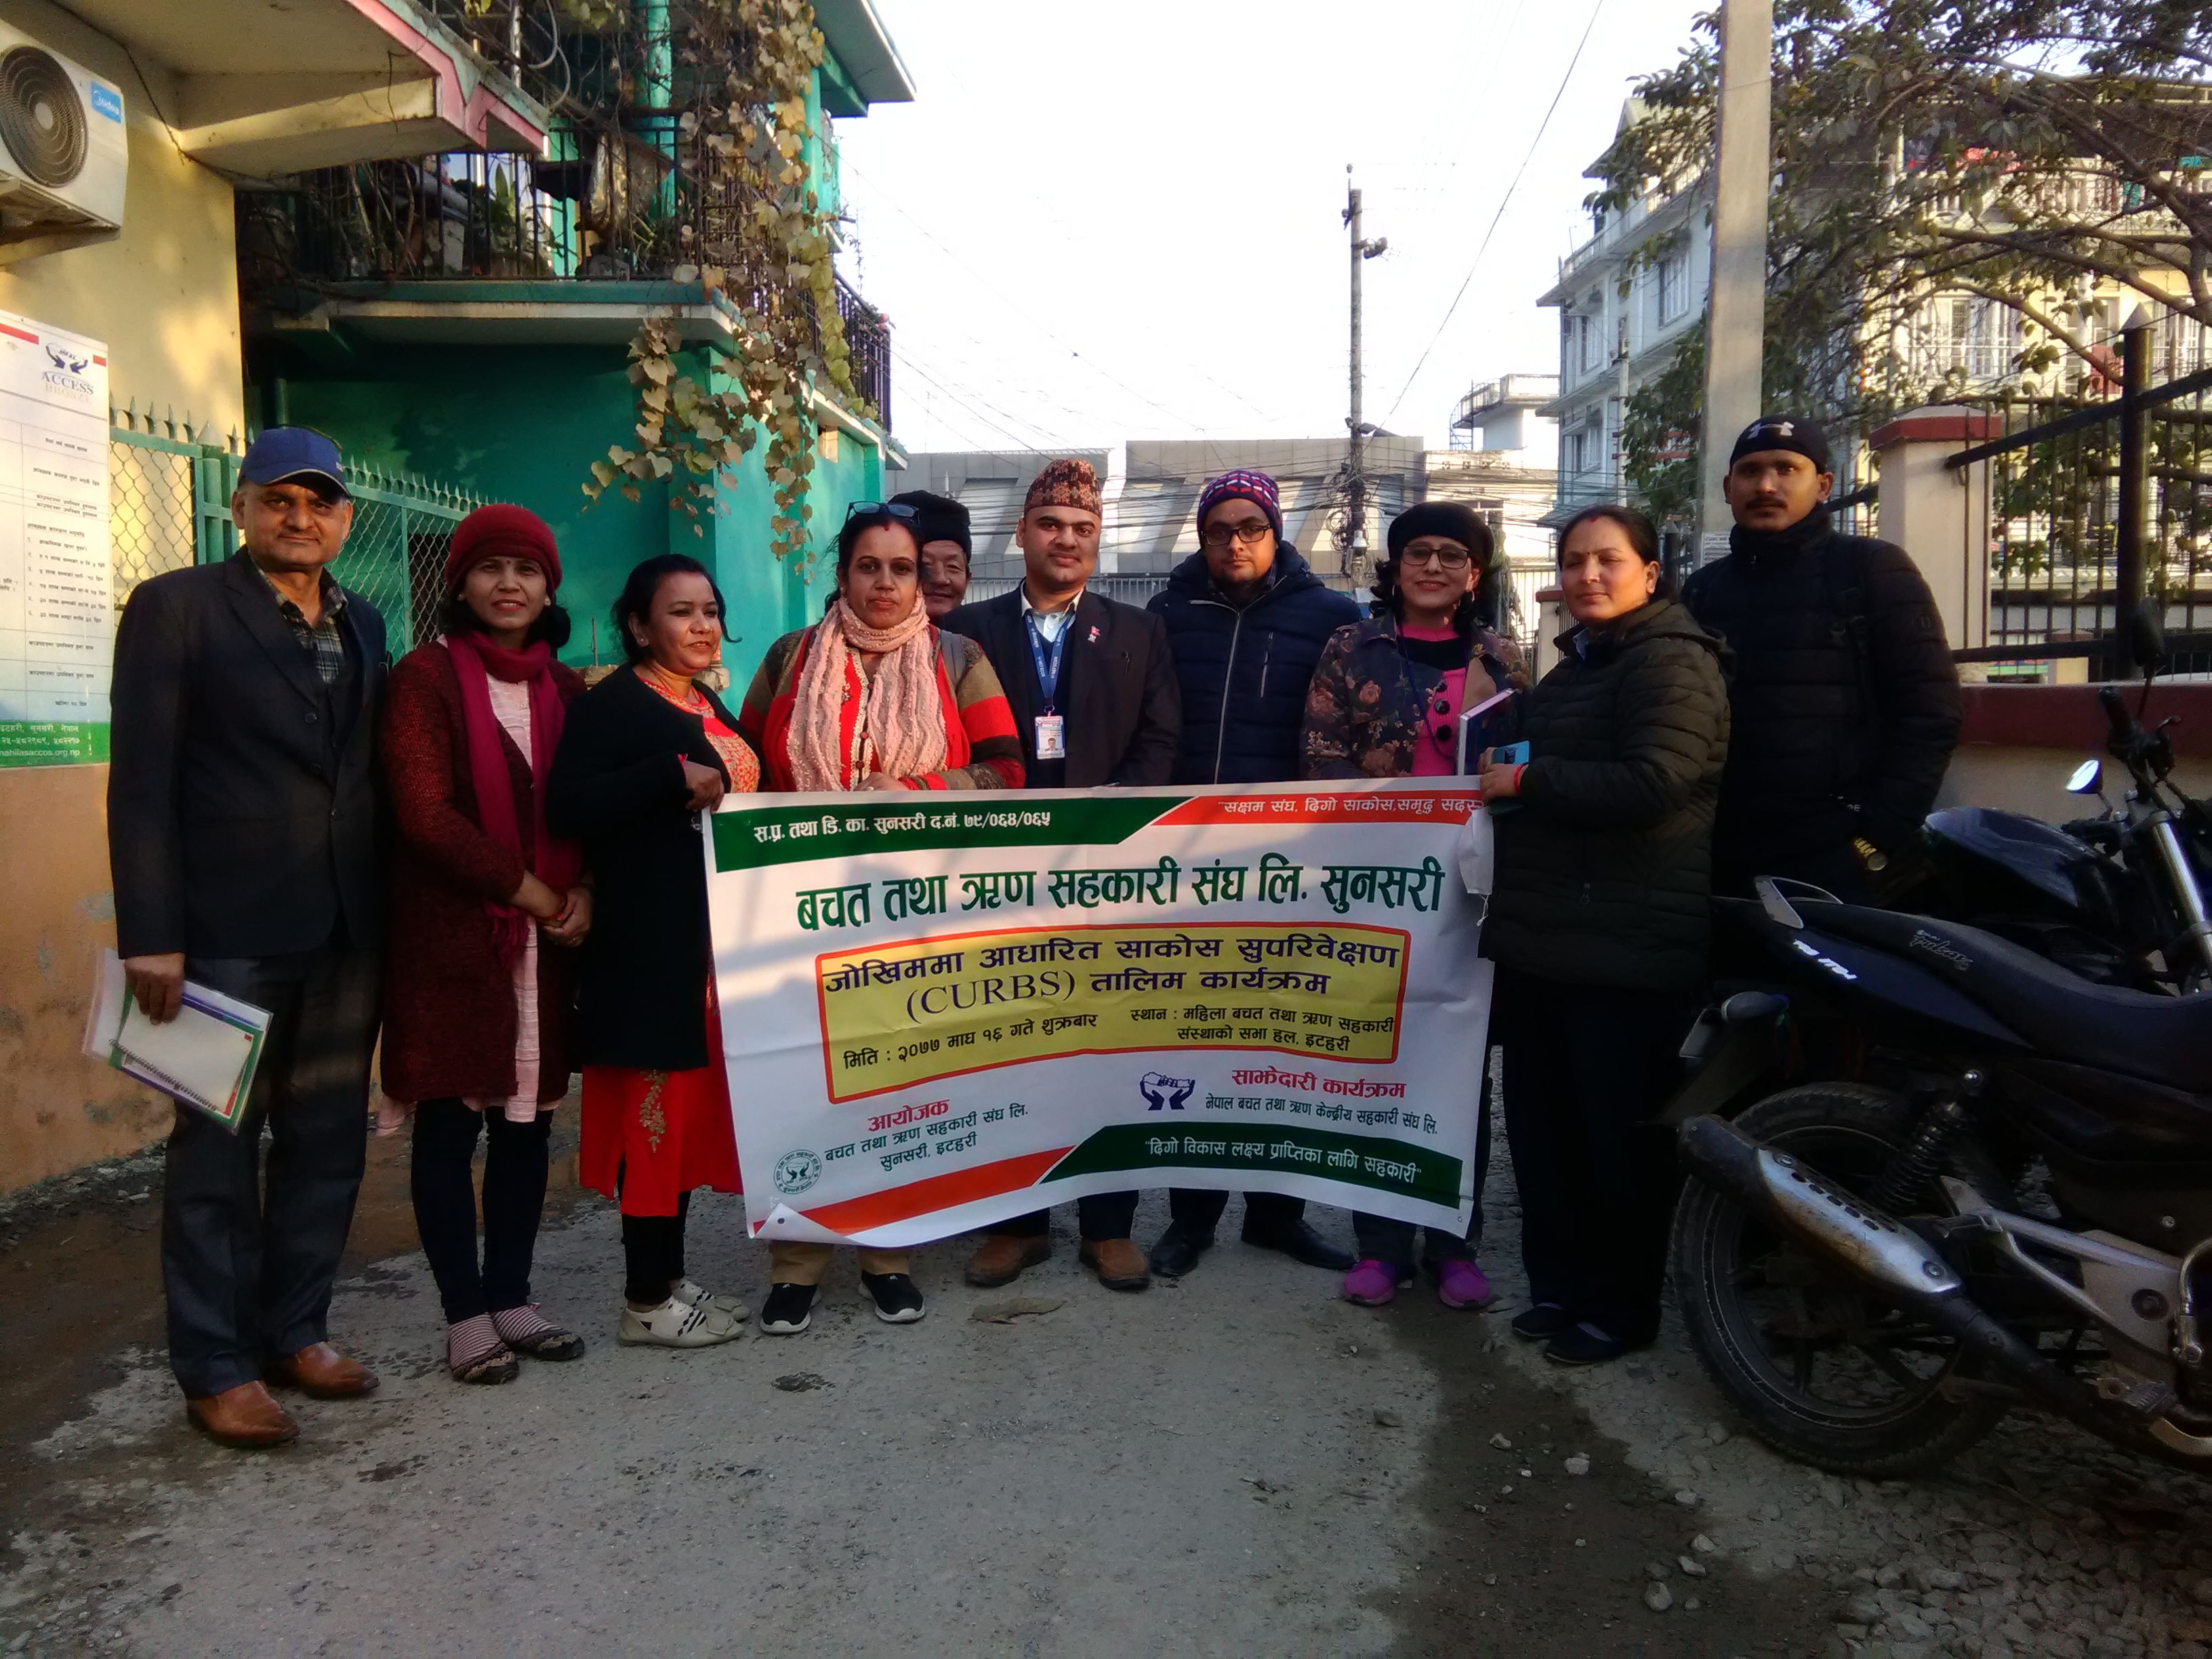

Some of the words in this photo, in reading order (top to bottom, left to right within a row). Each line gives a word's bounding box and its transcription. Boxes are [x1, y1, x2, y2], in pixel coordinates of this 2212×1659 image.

[41, 372, 94, 395] ACCESS
[45, 382, 92, 404] BRONZE
[61, 723, 79, 732] नेपाल
[1305, 796, 1338, 813] दिगो
[789, 821, 817, 838] तथा
[874, 812, 926, 834] सुनसरी
[796, 882, 872, 931] बचत
[882, 874, 949, 922] तथा
[959, 870, 1038, 911] ऋण
[1048, 855, 1182, 909] सहकारी
[1192, 859, 1249, 905] संघ
[1258, 852, 1308, 904] लि.
[1320, 855, 1446, 915] सुनसरी
[822, 951, 965, 993] जोखिममा
[979, 937, 1103, 970] आधारित
[1115, 933, 1224, 959] साकोस
[1237, 933, 1400, 968] सुपरिवेक्षण
[906, 969, 1076, 1024] (CURBS)
[1090, 967, 1187, 992] तालिम
[1200, 966, 1332, 995] कार्यक्रम
[1130, 1008, 1168, 1021] स्थान
[1183, 1004, 1226, 1021] महिला
[1231, 1007, 1264, 1020] बचत
[1269, 1007, 1297, 1023] तथा
[1302, 1012, 1333, 1027] ऋण
[1338, 1016, 1395, 1035] सहकारी
[844, 1047, 879, 1069] मिति
[898, 1040, 941, 1063] २०७७
[947, 1031, 976, 1048] माघ
[983, 1028, 1003, 1042] १६
[1010, 1018, 1035, 1036] गते
[1041, 1013, 1099, 1036] शुक्रबार
[1177, 1024, 1233, 1040] संस्थाको
[1239, 1027, 1267, 1040] सभा
[1305, 1033, 1351, 1052] इटहरी
[1231, 1065, 1317, 1092] साझेदारी
[1322, 1078, 1407, 1099] कार्यक्रम
[867, 1099, 950, 1132] आयोजक
[1206, 1092, 1234, 1110] नेपाल
[1237, 1097, 1262, 1111] बचत
[1265, 1098, 1286, 1111] तथा
[1290, 1100, 1312, 1115] ऋण
[1315, 1101, 1353, 1122] केन्द्रीय
[1357, 1107, 1399, 1126] सहकारी
[1402, 1110, 1420, 1130] संघ
[1423, 1113, 1438, 1134] लि.
[824, 1143, 856, 1162] बचत
[860, 1135, 888, 1153] तथा
[892, 1126, 921, 1145] ऋण
[926, 1111, 977, 1136] सहकारी
[982, 1107, 1004, 1123] संघ
[1009, 1103, 1029, 1118] लि.
[880, 1143, 931, 1172] सुनसरी,
[935, 1131, 978, 1155] इटहरी
[1183, 1136, 1227, 1156] विकास
[1231, 1141, 1265, 1160] लक्ष्य
[1269, 1140, 1322, 1164] प्राप्तिका
[1327, 1149, 1359, 1169] लागि
